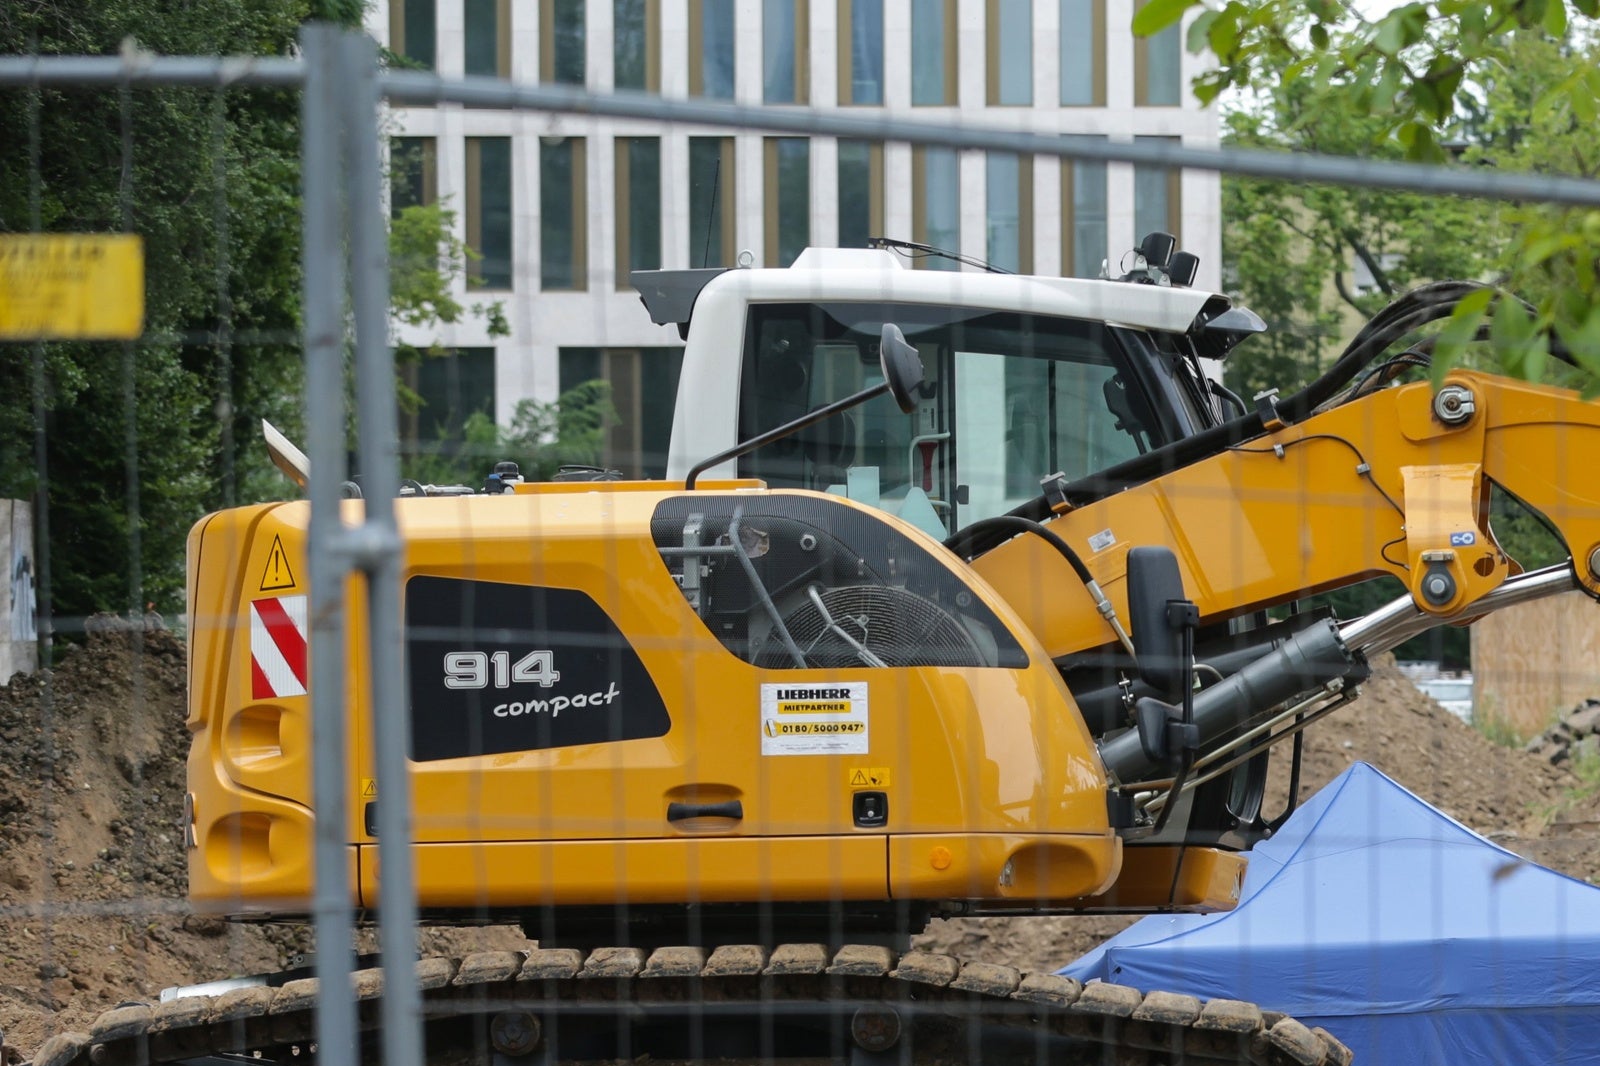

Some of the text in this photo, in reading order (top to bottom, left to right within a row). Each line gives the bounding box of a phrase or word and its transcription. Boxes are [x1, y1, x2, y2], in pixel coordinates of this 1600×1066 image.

[443, 649, 560, 690] 914
[493, 681, 620, 717] compact
[777, 688, 851, 700] LIEBHERR
[783, 703, 845, 711] MIETPARTNER
